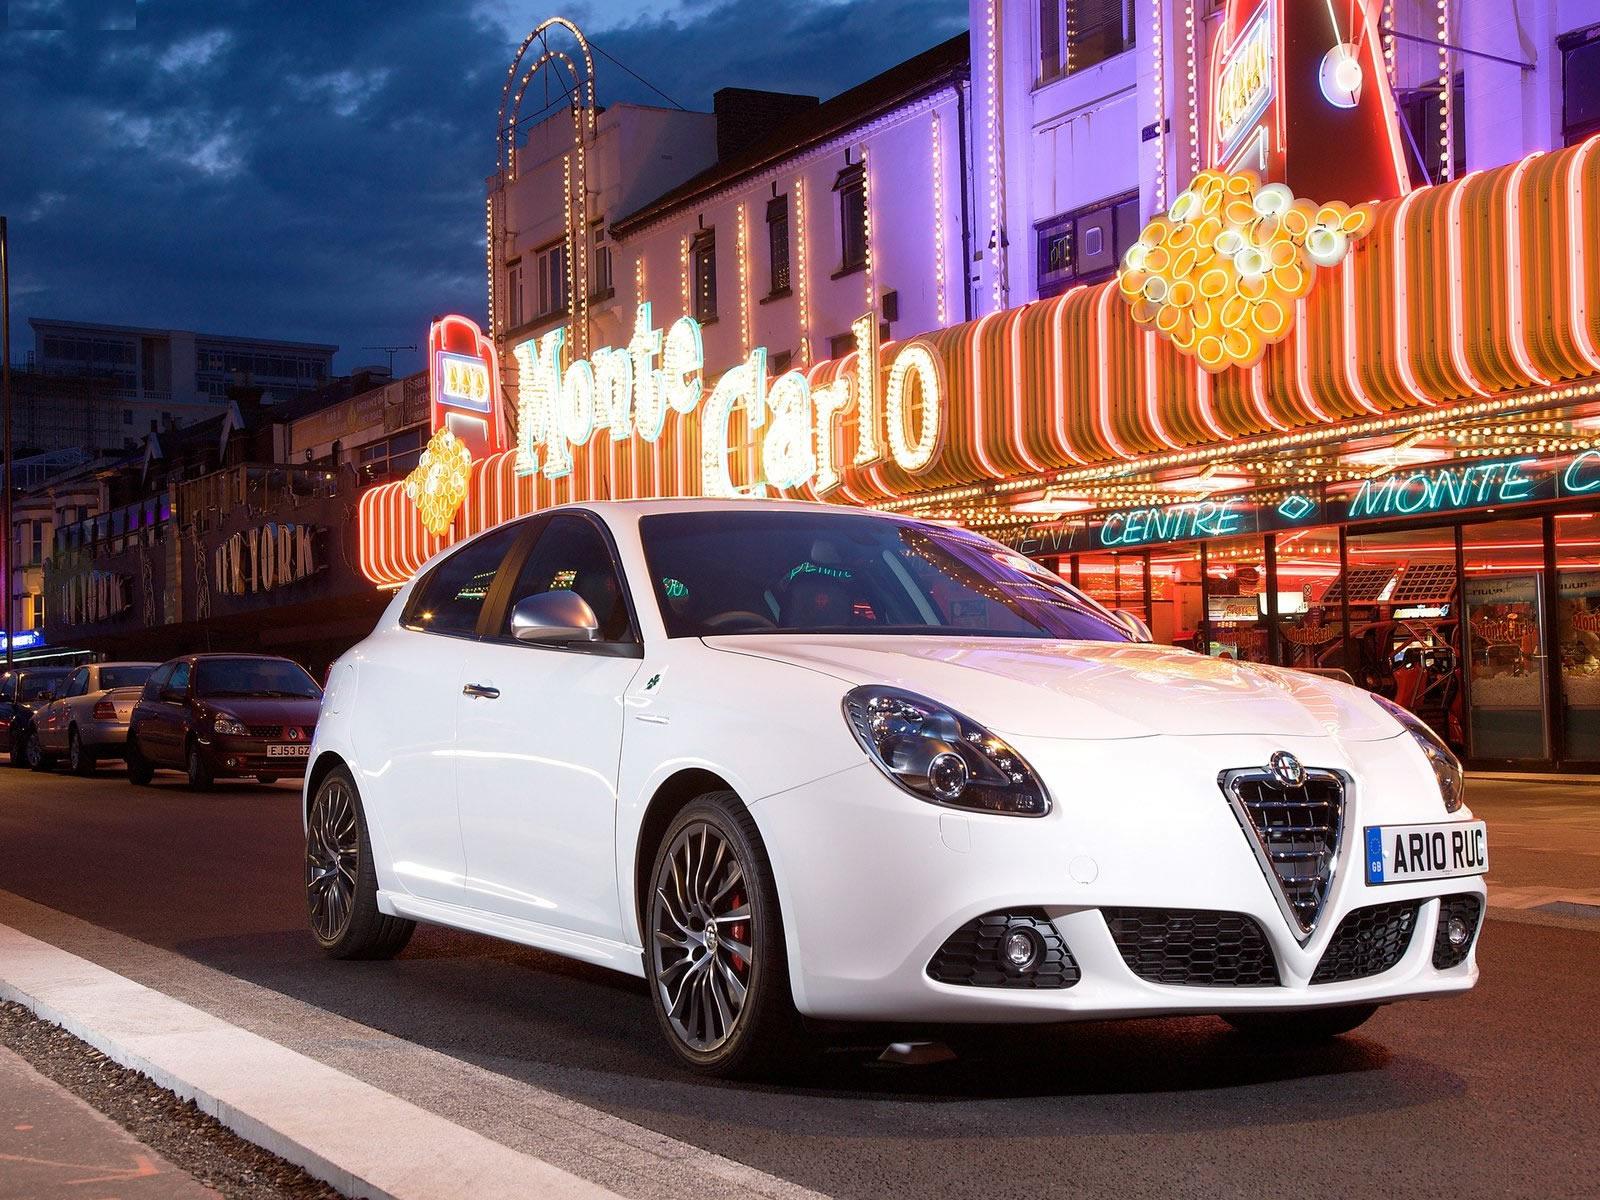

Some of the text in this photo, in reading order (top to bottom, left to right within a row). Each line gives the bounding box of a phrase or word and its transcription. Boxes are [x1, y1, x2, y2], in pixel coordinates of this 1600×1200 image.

[513, 301, 947, 499] Monte Carlo
[1100, 497, 1244, 546] CENTRE
[1349, 458, 1537, 517] MONTE
[270, 746, 310, 756] EJ53 GZ
[1371, 861, 1382, 873] GB
[1452, 828, 1484, 869] RUC
